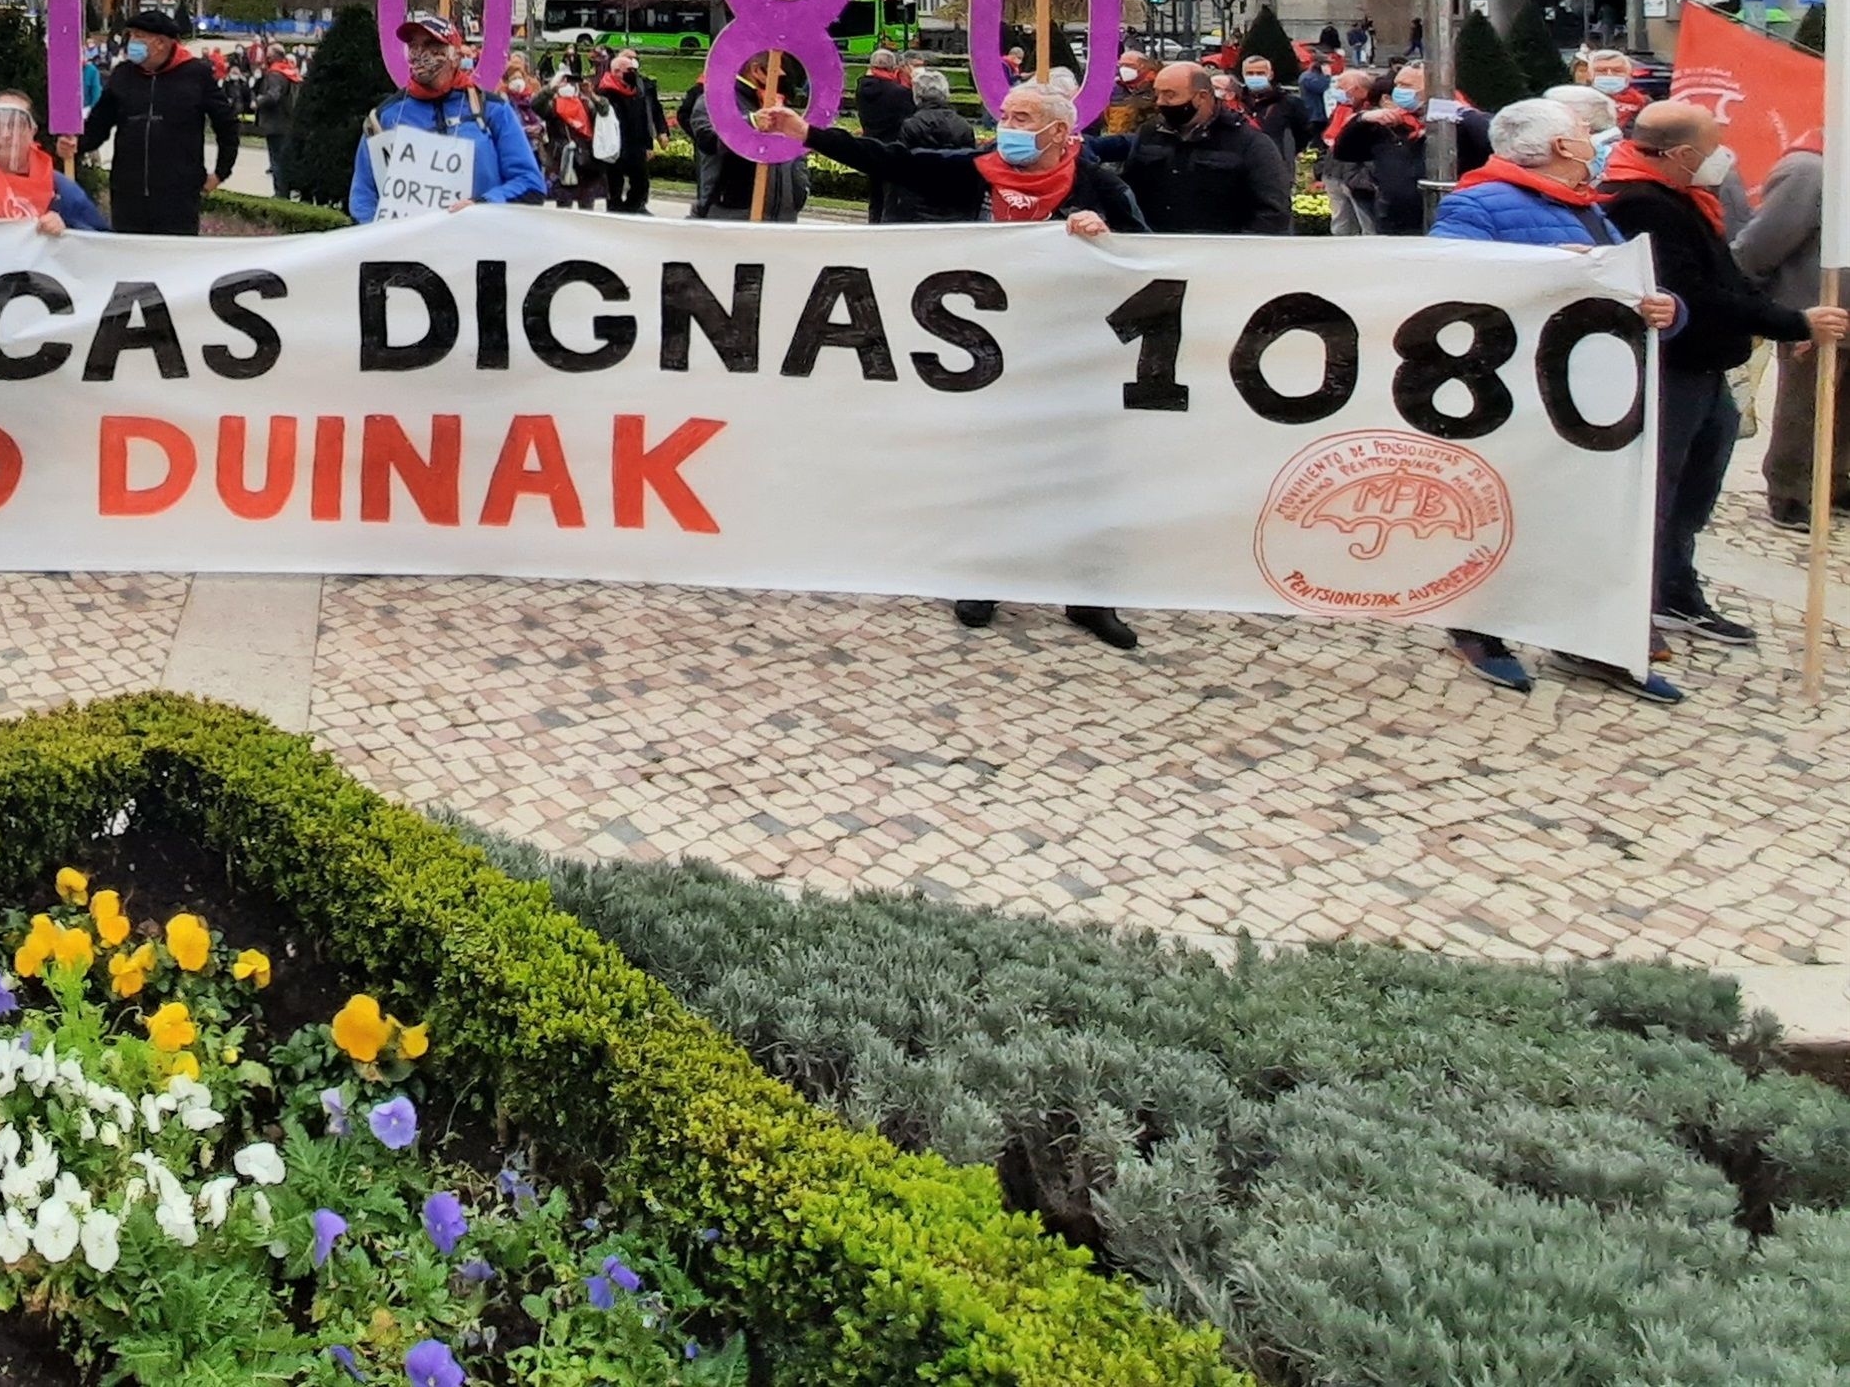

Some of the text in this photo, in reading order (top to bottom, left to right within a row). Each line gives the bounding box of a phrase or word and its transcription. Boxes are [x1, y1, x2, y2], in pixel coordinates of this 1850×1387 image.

[400, 143, 416, 163] A
[358, 258, 1010, 393] DIGNAS
[1105, 277, 1648, 453] 1080
[96, 413, 728, 536] DUINAK
[1275, 451, 1344, 515] MOVIMIENTO
[1352, 479, 1448, 519] MPB
